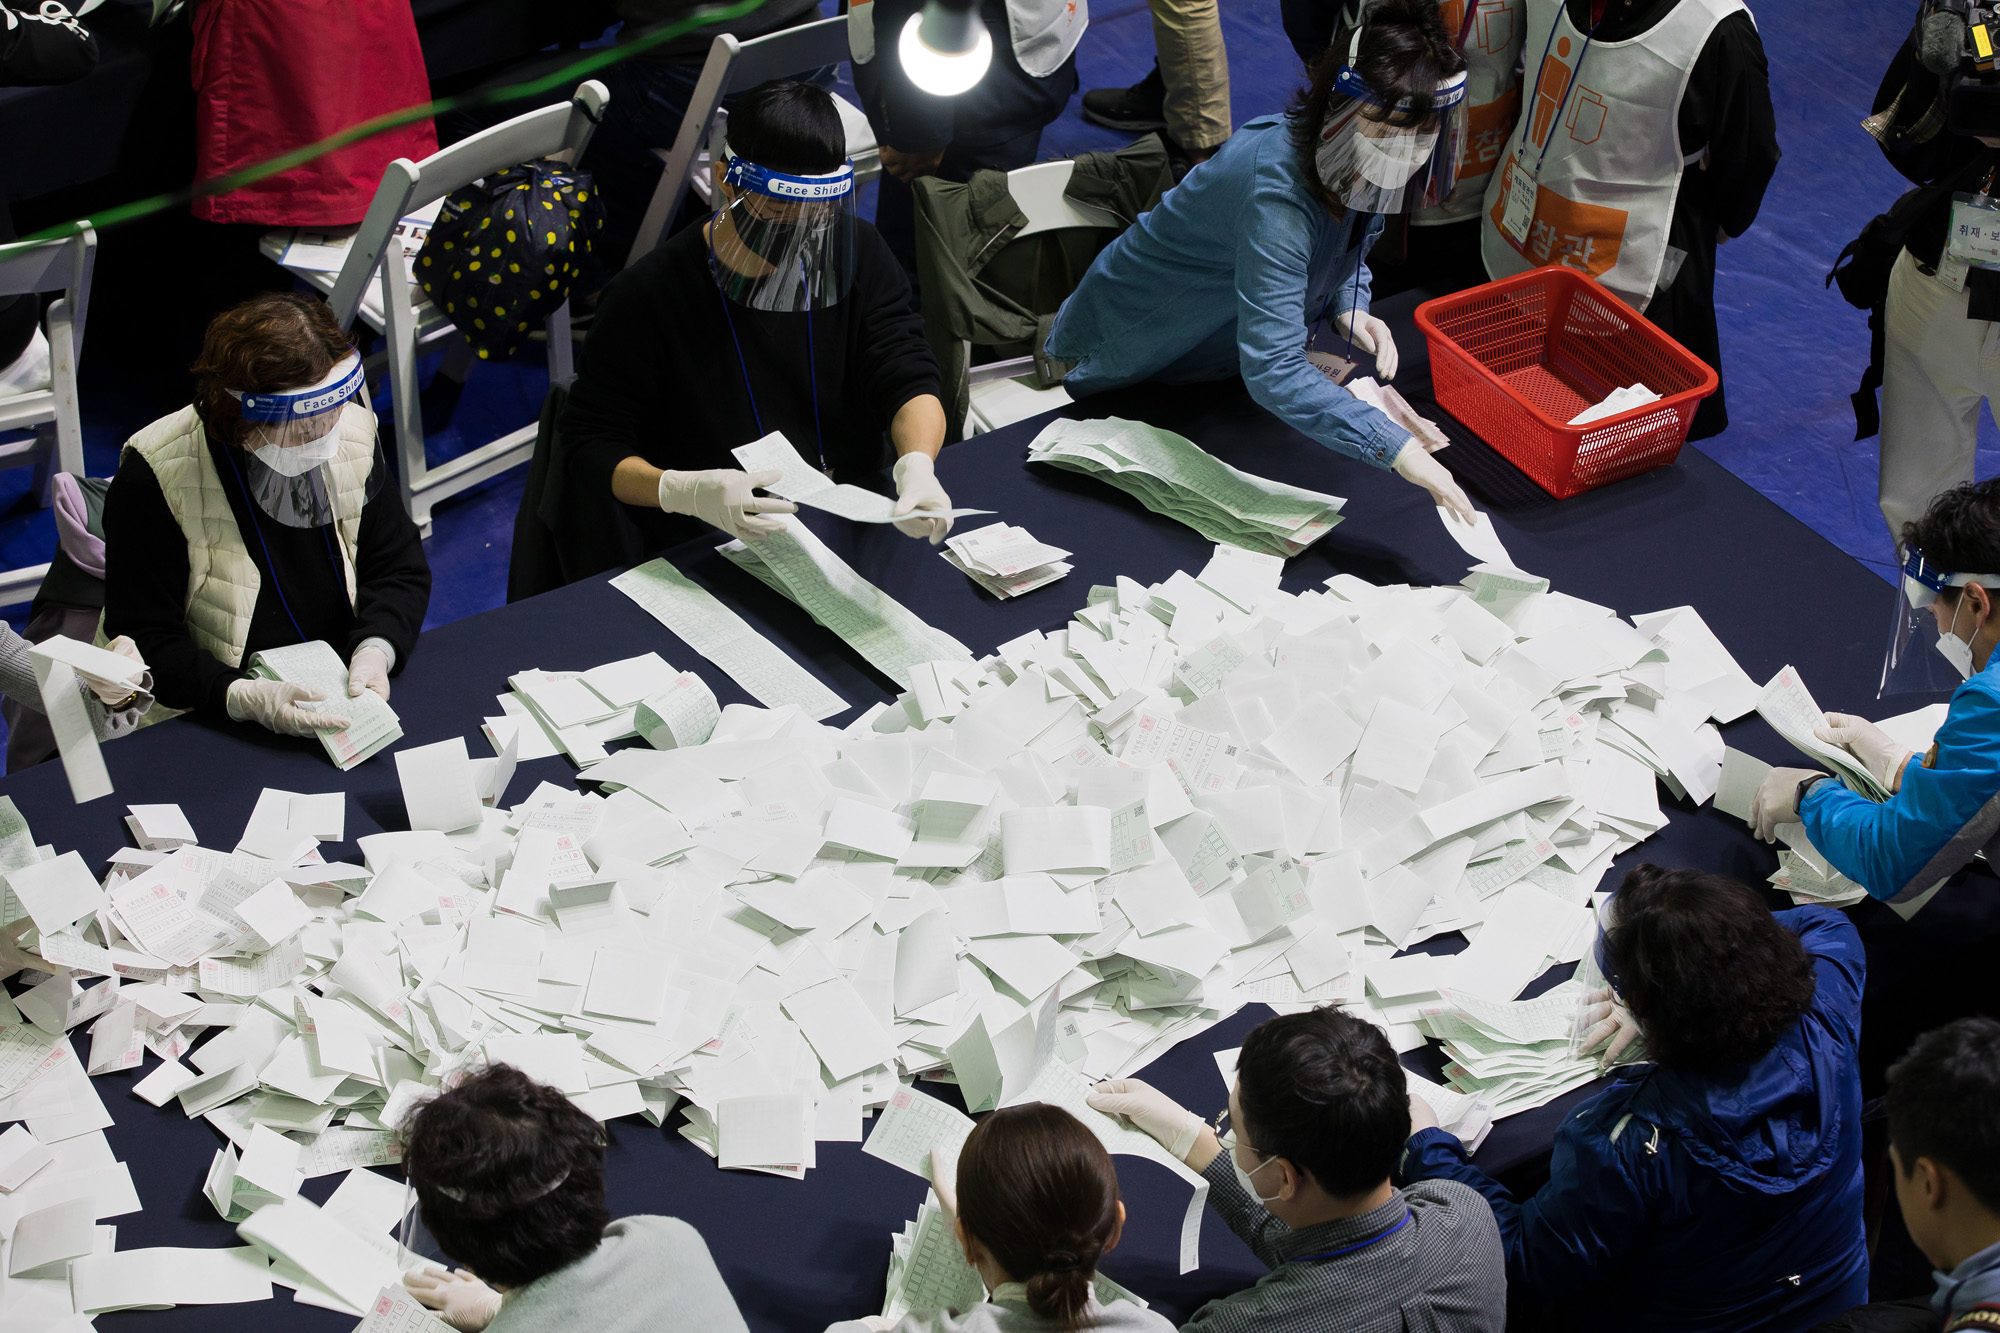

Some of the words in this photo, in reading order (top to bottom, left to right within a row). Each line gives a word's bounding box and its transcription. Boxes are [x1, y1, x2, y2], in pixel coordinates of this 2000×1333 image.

[777, 182, 808, 195] Face
[813, 182, 847, 196] Shield
[1309, 361, 1342, 378] 사무원
[303, 394, 334, 411] Face
[338, 370, 363, 398] Shield
